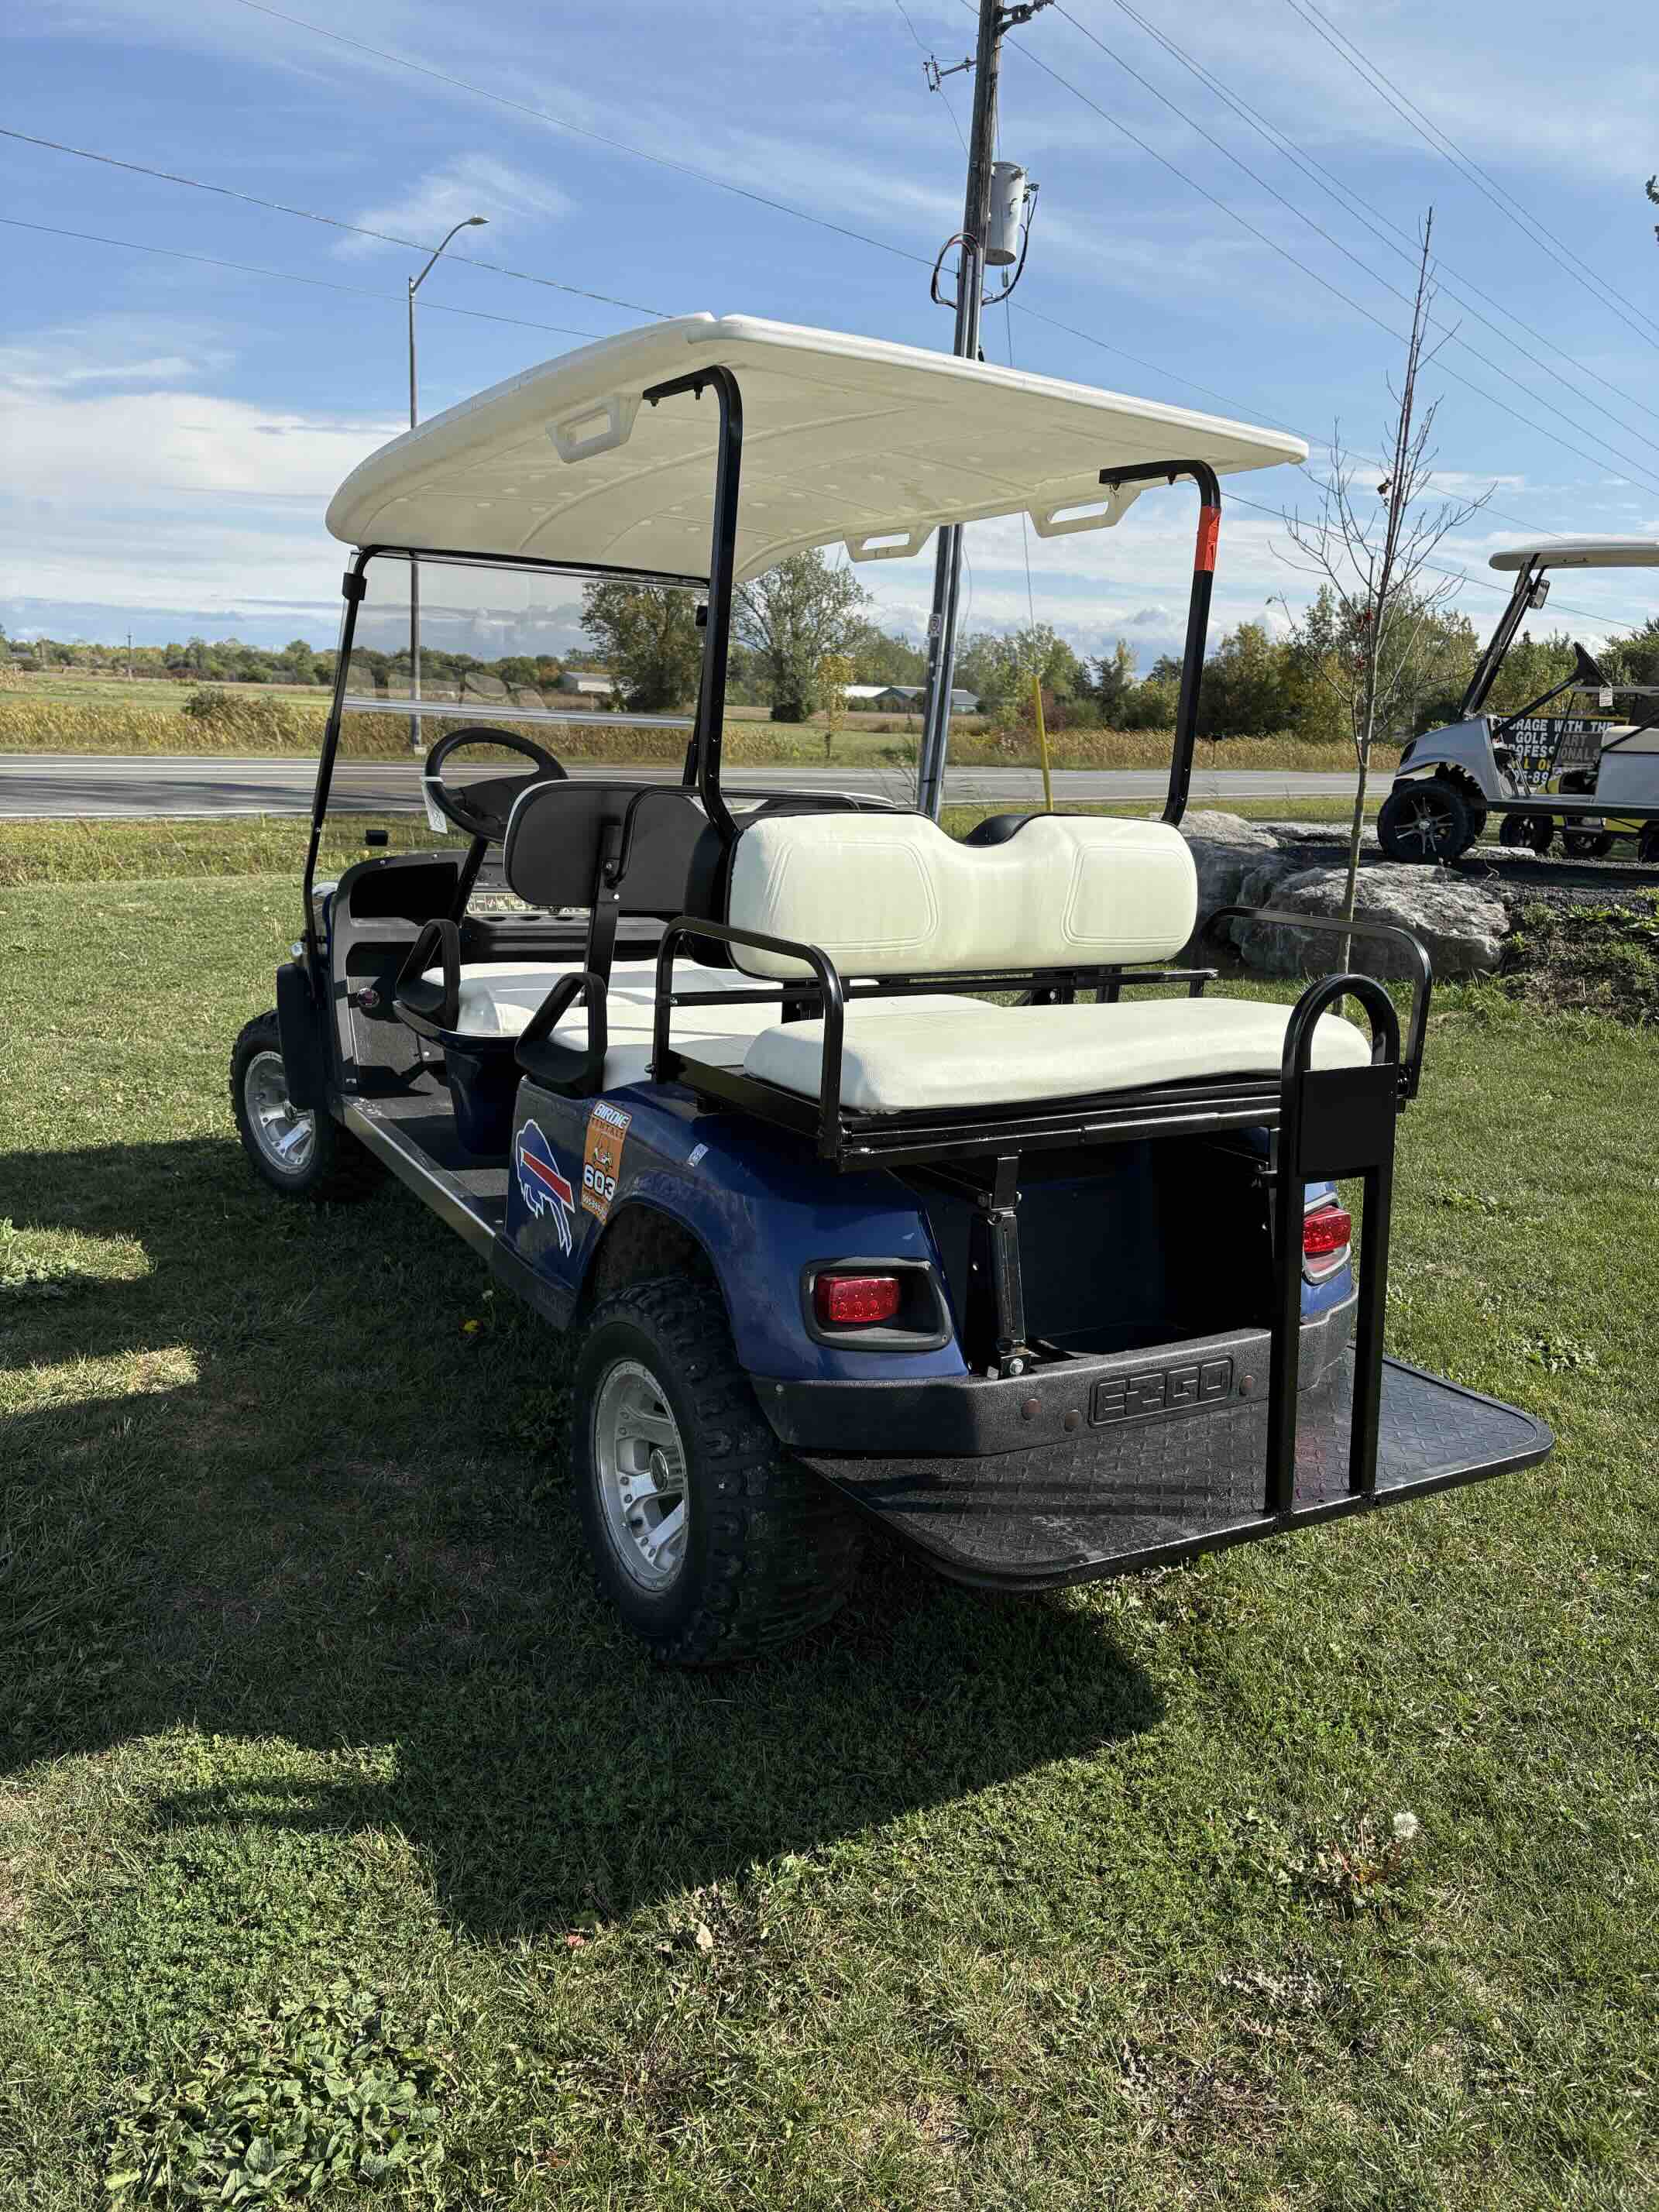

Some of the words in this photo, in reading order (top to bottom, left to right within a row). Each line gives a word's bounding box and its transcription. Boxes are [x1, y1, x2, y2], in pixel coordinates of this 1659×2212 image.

[1515, 731, 1548, 744] GOLF
[593, 1103, 630, 1128] BIRDIE
[583, 1163, 616, 1202] 603
[1094, 1358, 1231, 1424] EZGO
